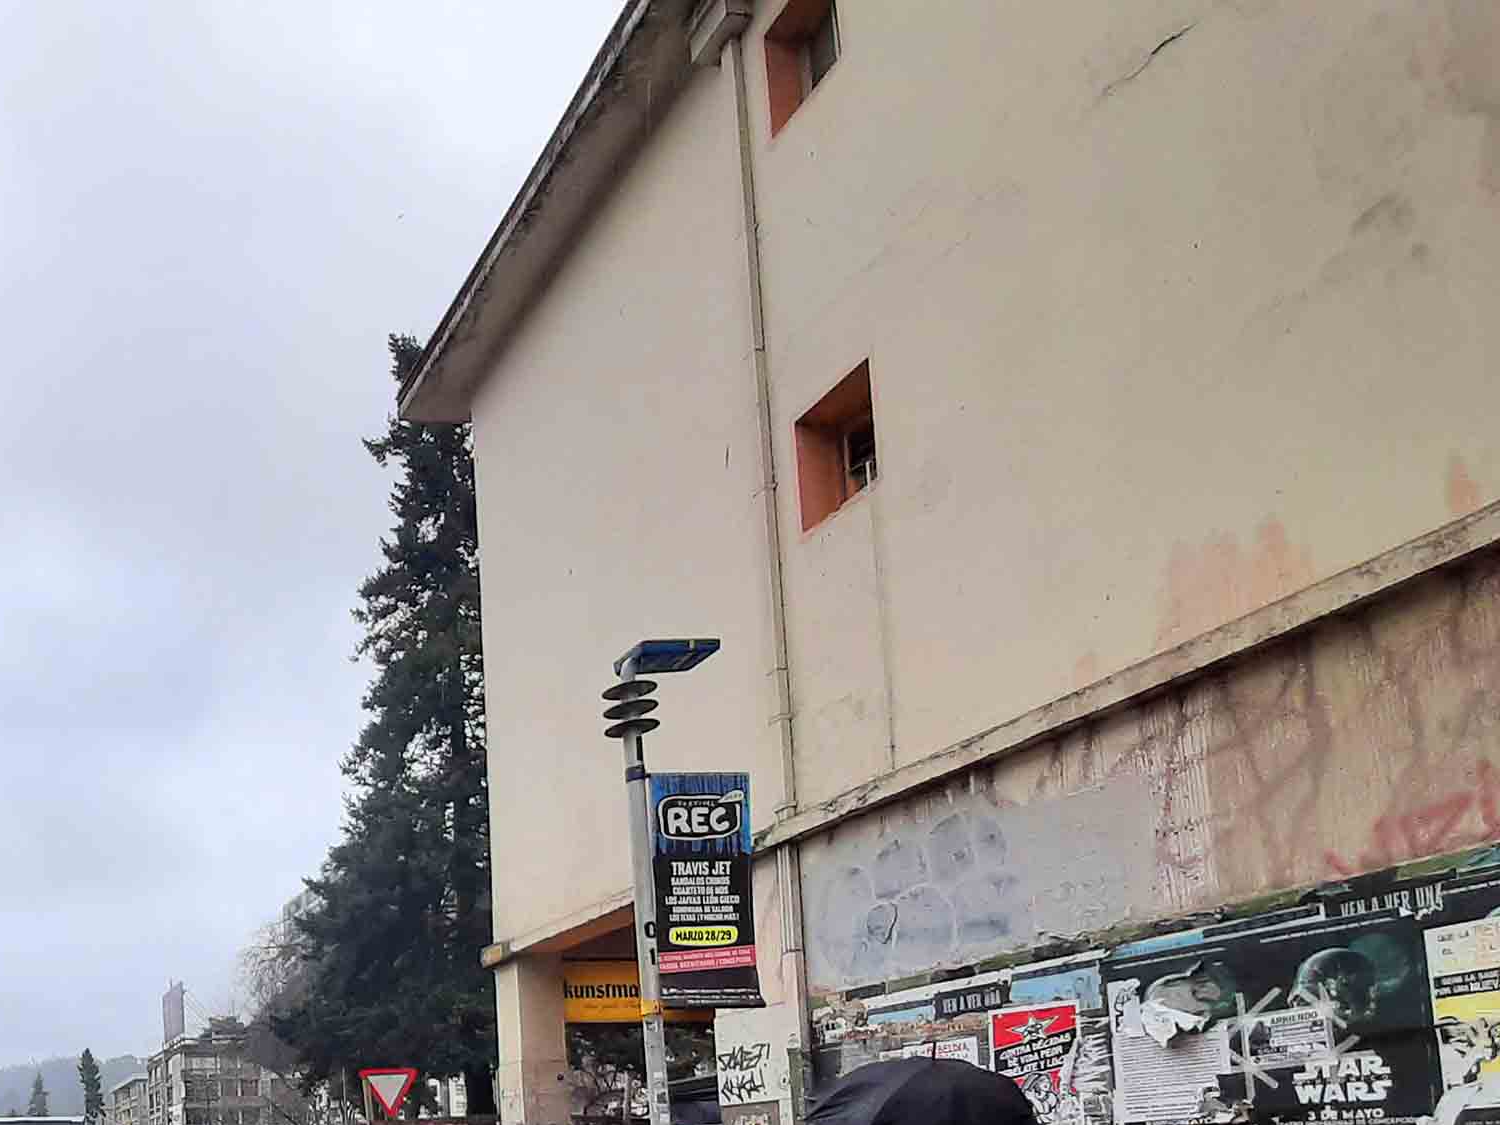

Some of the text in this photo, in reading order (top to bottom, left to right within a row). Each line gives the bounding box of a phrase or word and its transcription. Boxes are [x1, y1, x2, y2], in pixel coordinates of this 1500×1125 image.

[667, 806, 730, 834] REC
[671, 861, 731, 875] TRAVIS JET
[675, 930, 732, 942] MARZO 28/29
[563, 980, 640, 999] kunstma
[1292, 1055, 1392, 1081] STAR
[1293, 1079, 1394, 1104] WARS
[1307, 1110, 1317, 1122] 3
[1341, 1107, 1385, 1120] MAYO
